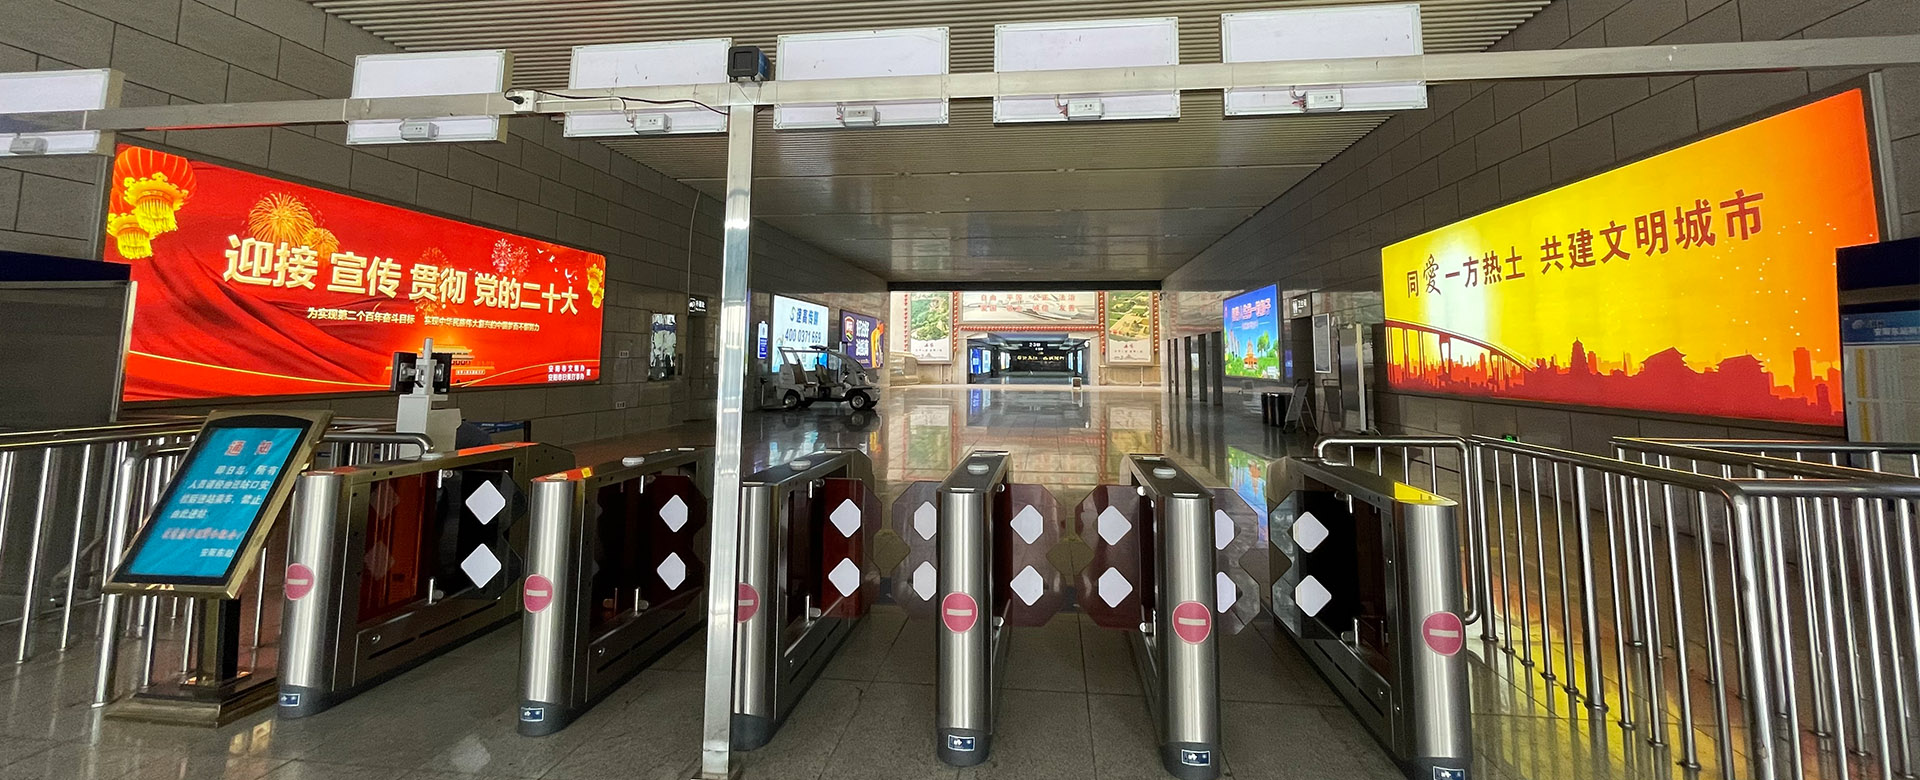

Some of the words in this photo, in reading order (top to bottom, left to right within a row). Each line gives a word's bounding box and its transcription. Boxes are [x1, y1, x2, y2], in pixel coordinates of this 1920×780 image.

[1540, 189, 1765, 273] 共建文明城市
[222, 234, 318, 290] 迎接
[327, 251, 402, 299] 宣传
[408, 263, 467, 306] 贯彻
[474, 273, 580, 316] 党的二十大
[307, 307, 415, 324] 为实现第二个百年奋斗目标
